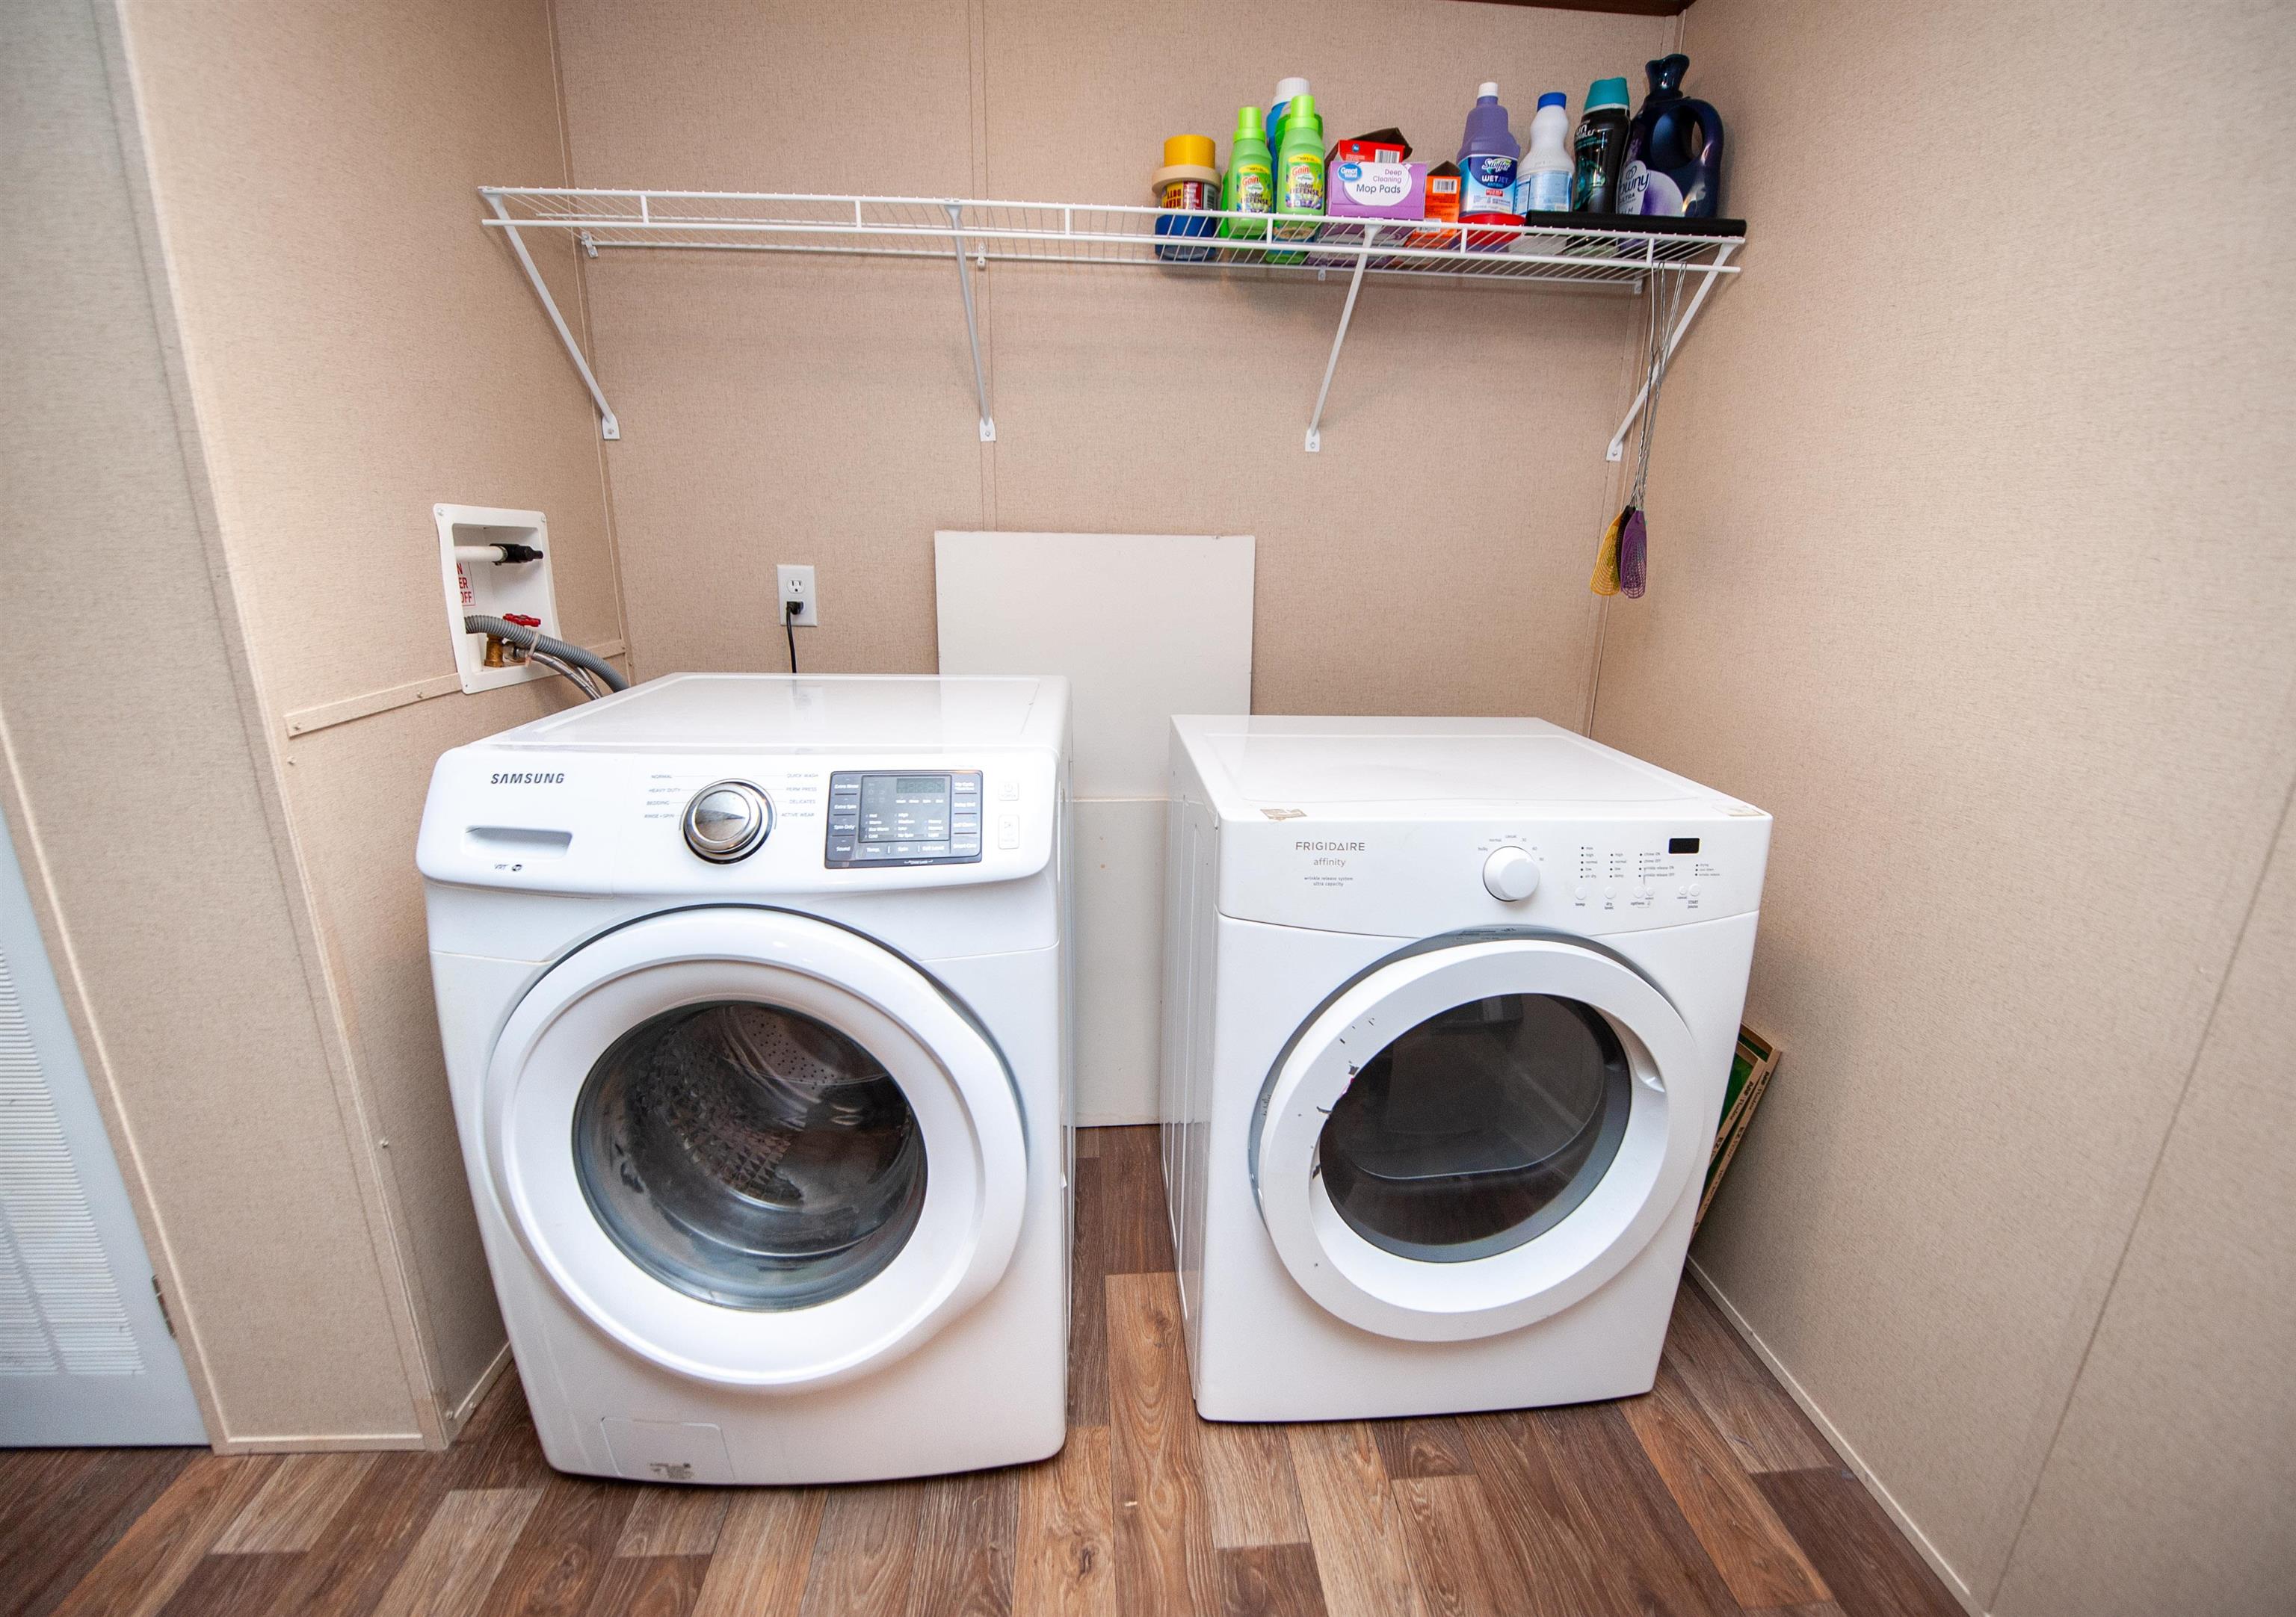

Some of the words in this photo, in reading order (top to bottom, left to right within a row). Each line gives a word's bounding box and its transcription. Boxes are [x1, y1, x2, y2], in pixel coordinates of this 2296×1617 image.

[1292, 165, 1309, 176] Gain
[1481, 158, 1511, 173] Swiffer
[1242, 176, 1259, 186] Gain
[1372, 176, 1402, 184] Cleaning
[1619, 173, 1649, 195] owny
[1356, 184, 1377, 194] Mop
[1379, 185, 1401, 194] Pads
[491, 773, 565, 785] SAMSUNG
[1295, 841, 1366, 851] FRIGIDAIRE
[1313, 858, 1346, 868] affinity
